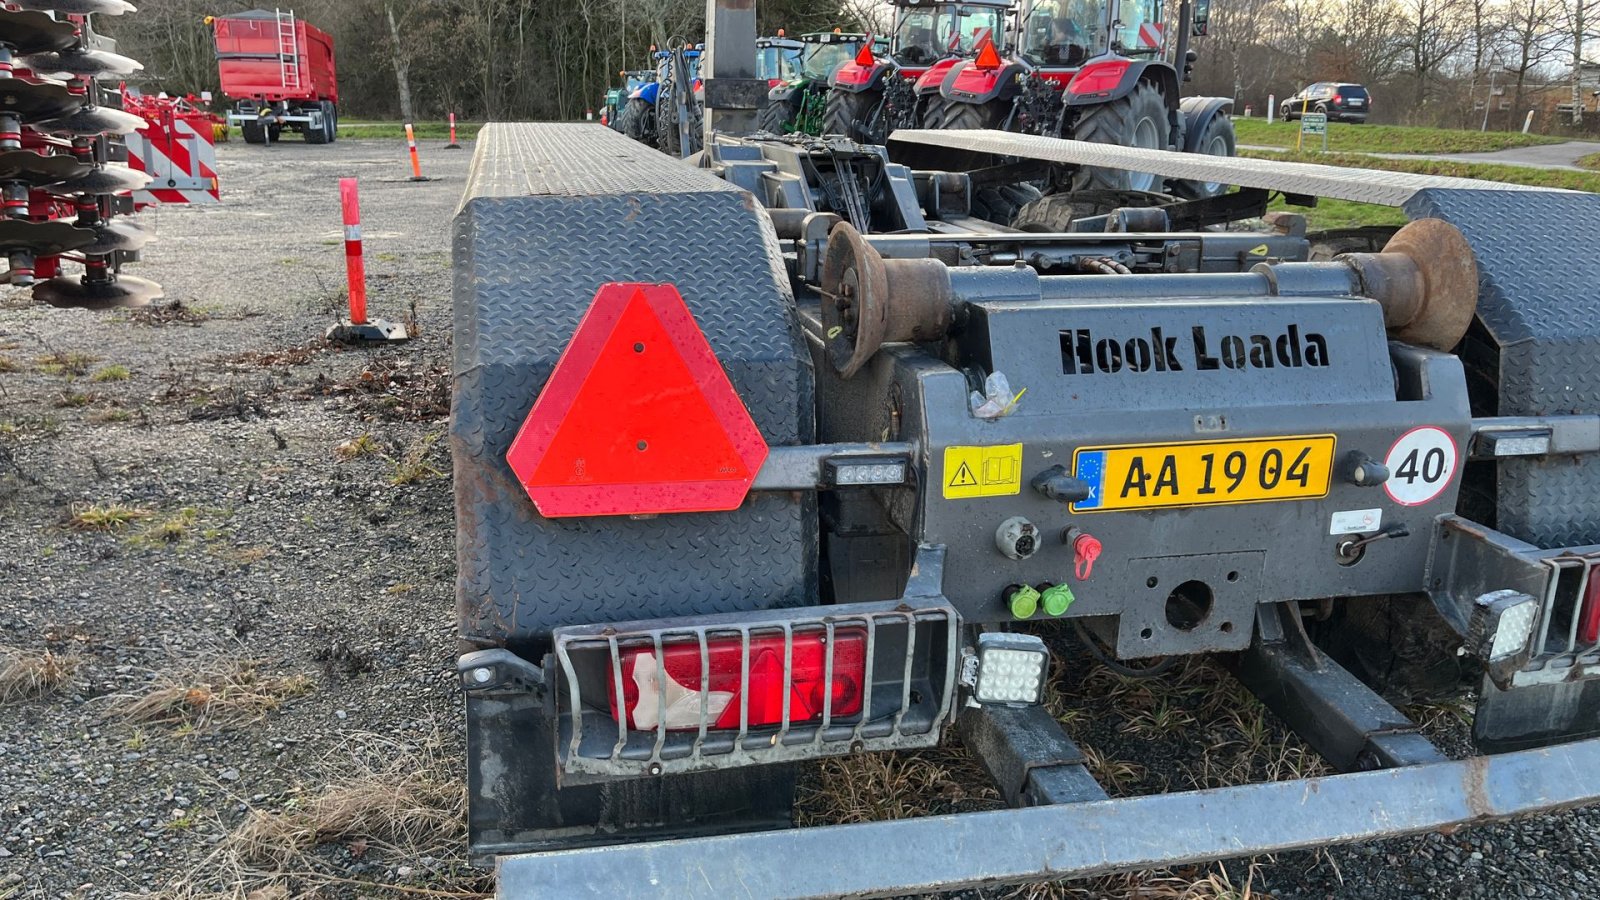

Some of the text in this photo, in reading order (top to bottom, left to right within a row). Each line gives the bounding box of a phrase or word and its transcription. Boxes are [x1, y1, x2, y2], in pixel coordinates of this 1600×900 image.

[1058, 323, 1330, 375] Hook Loada
[1119, 456, 1179, 499] AA
[1394, 446, 1446, 485] 40
